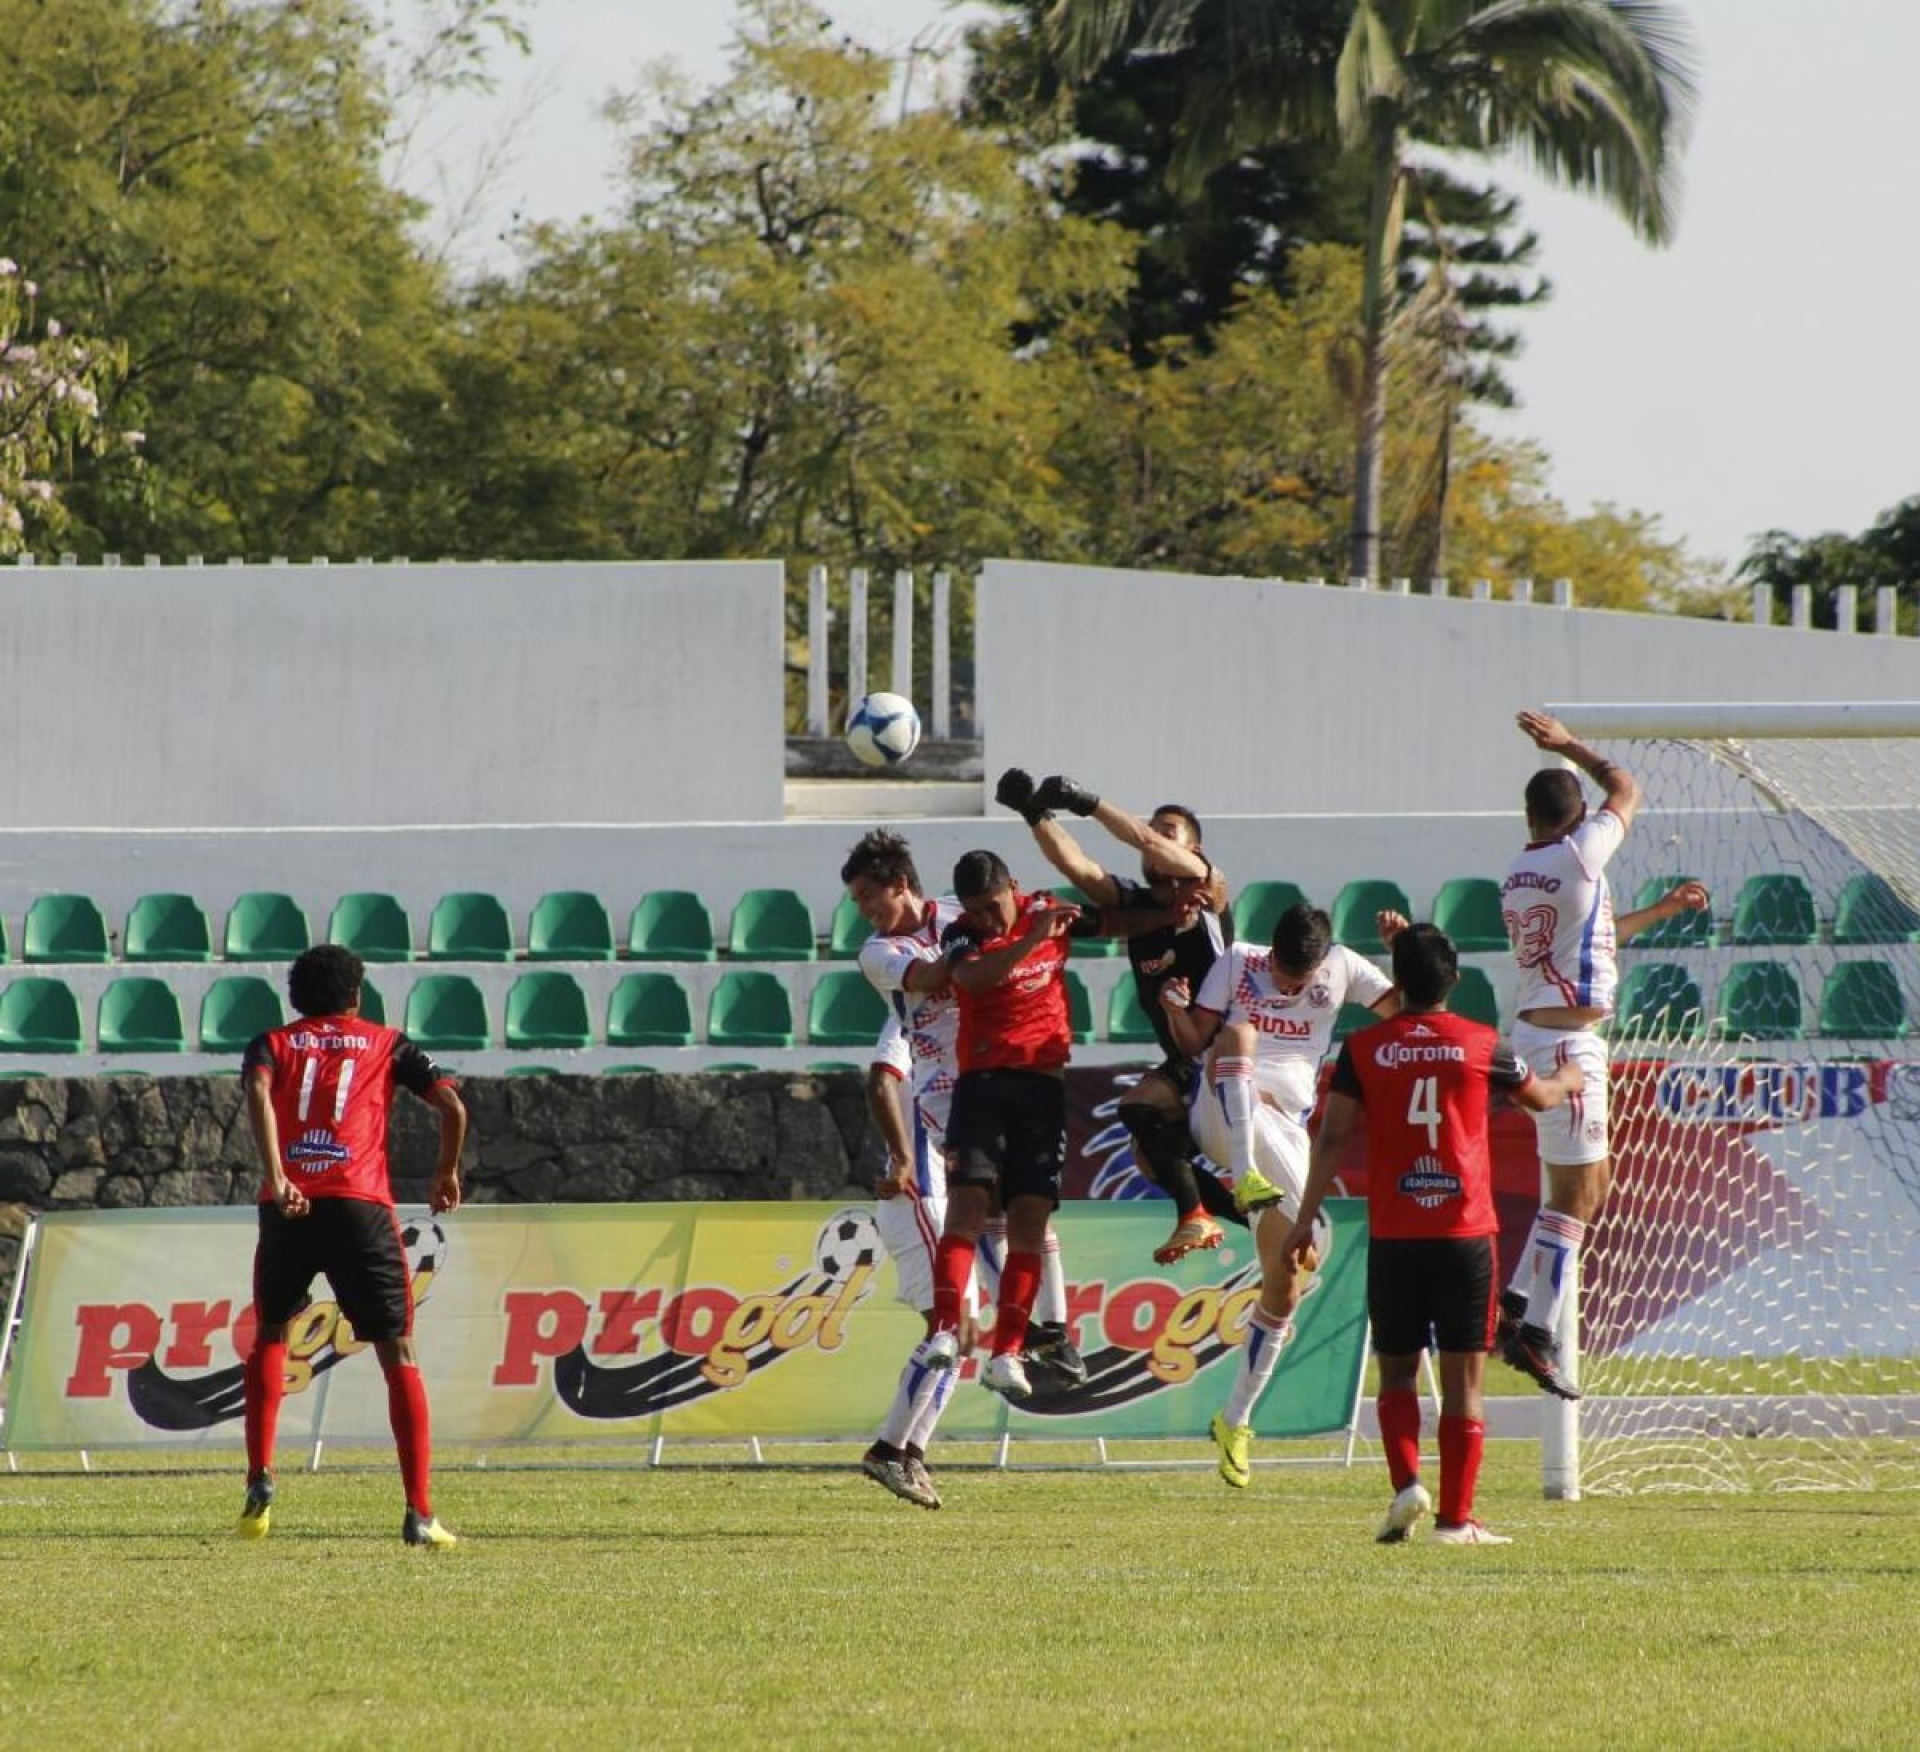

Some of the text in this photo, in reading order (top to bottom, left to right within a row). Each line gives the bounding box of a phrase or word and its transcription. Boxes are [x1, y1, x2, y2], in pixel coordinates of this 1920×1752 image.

[289, 1031, 371, 1049] Corona
[1373, 1042, 1466, 1069] Corona
[298, 1056, 355, 1122] 11
[1407, 1076, 1442, 1150] 4
[1658, 1064, 1868, 1120] CLUB
[492, 1264, 876, 1387] progol
